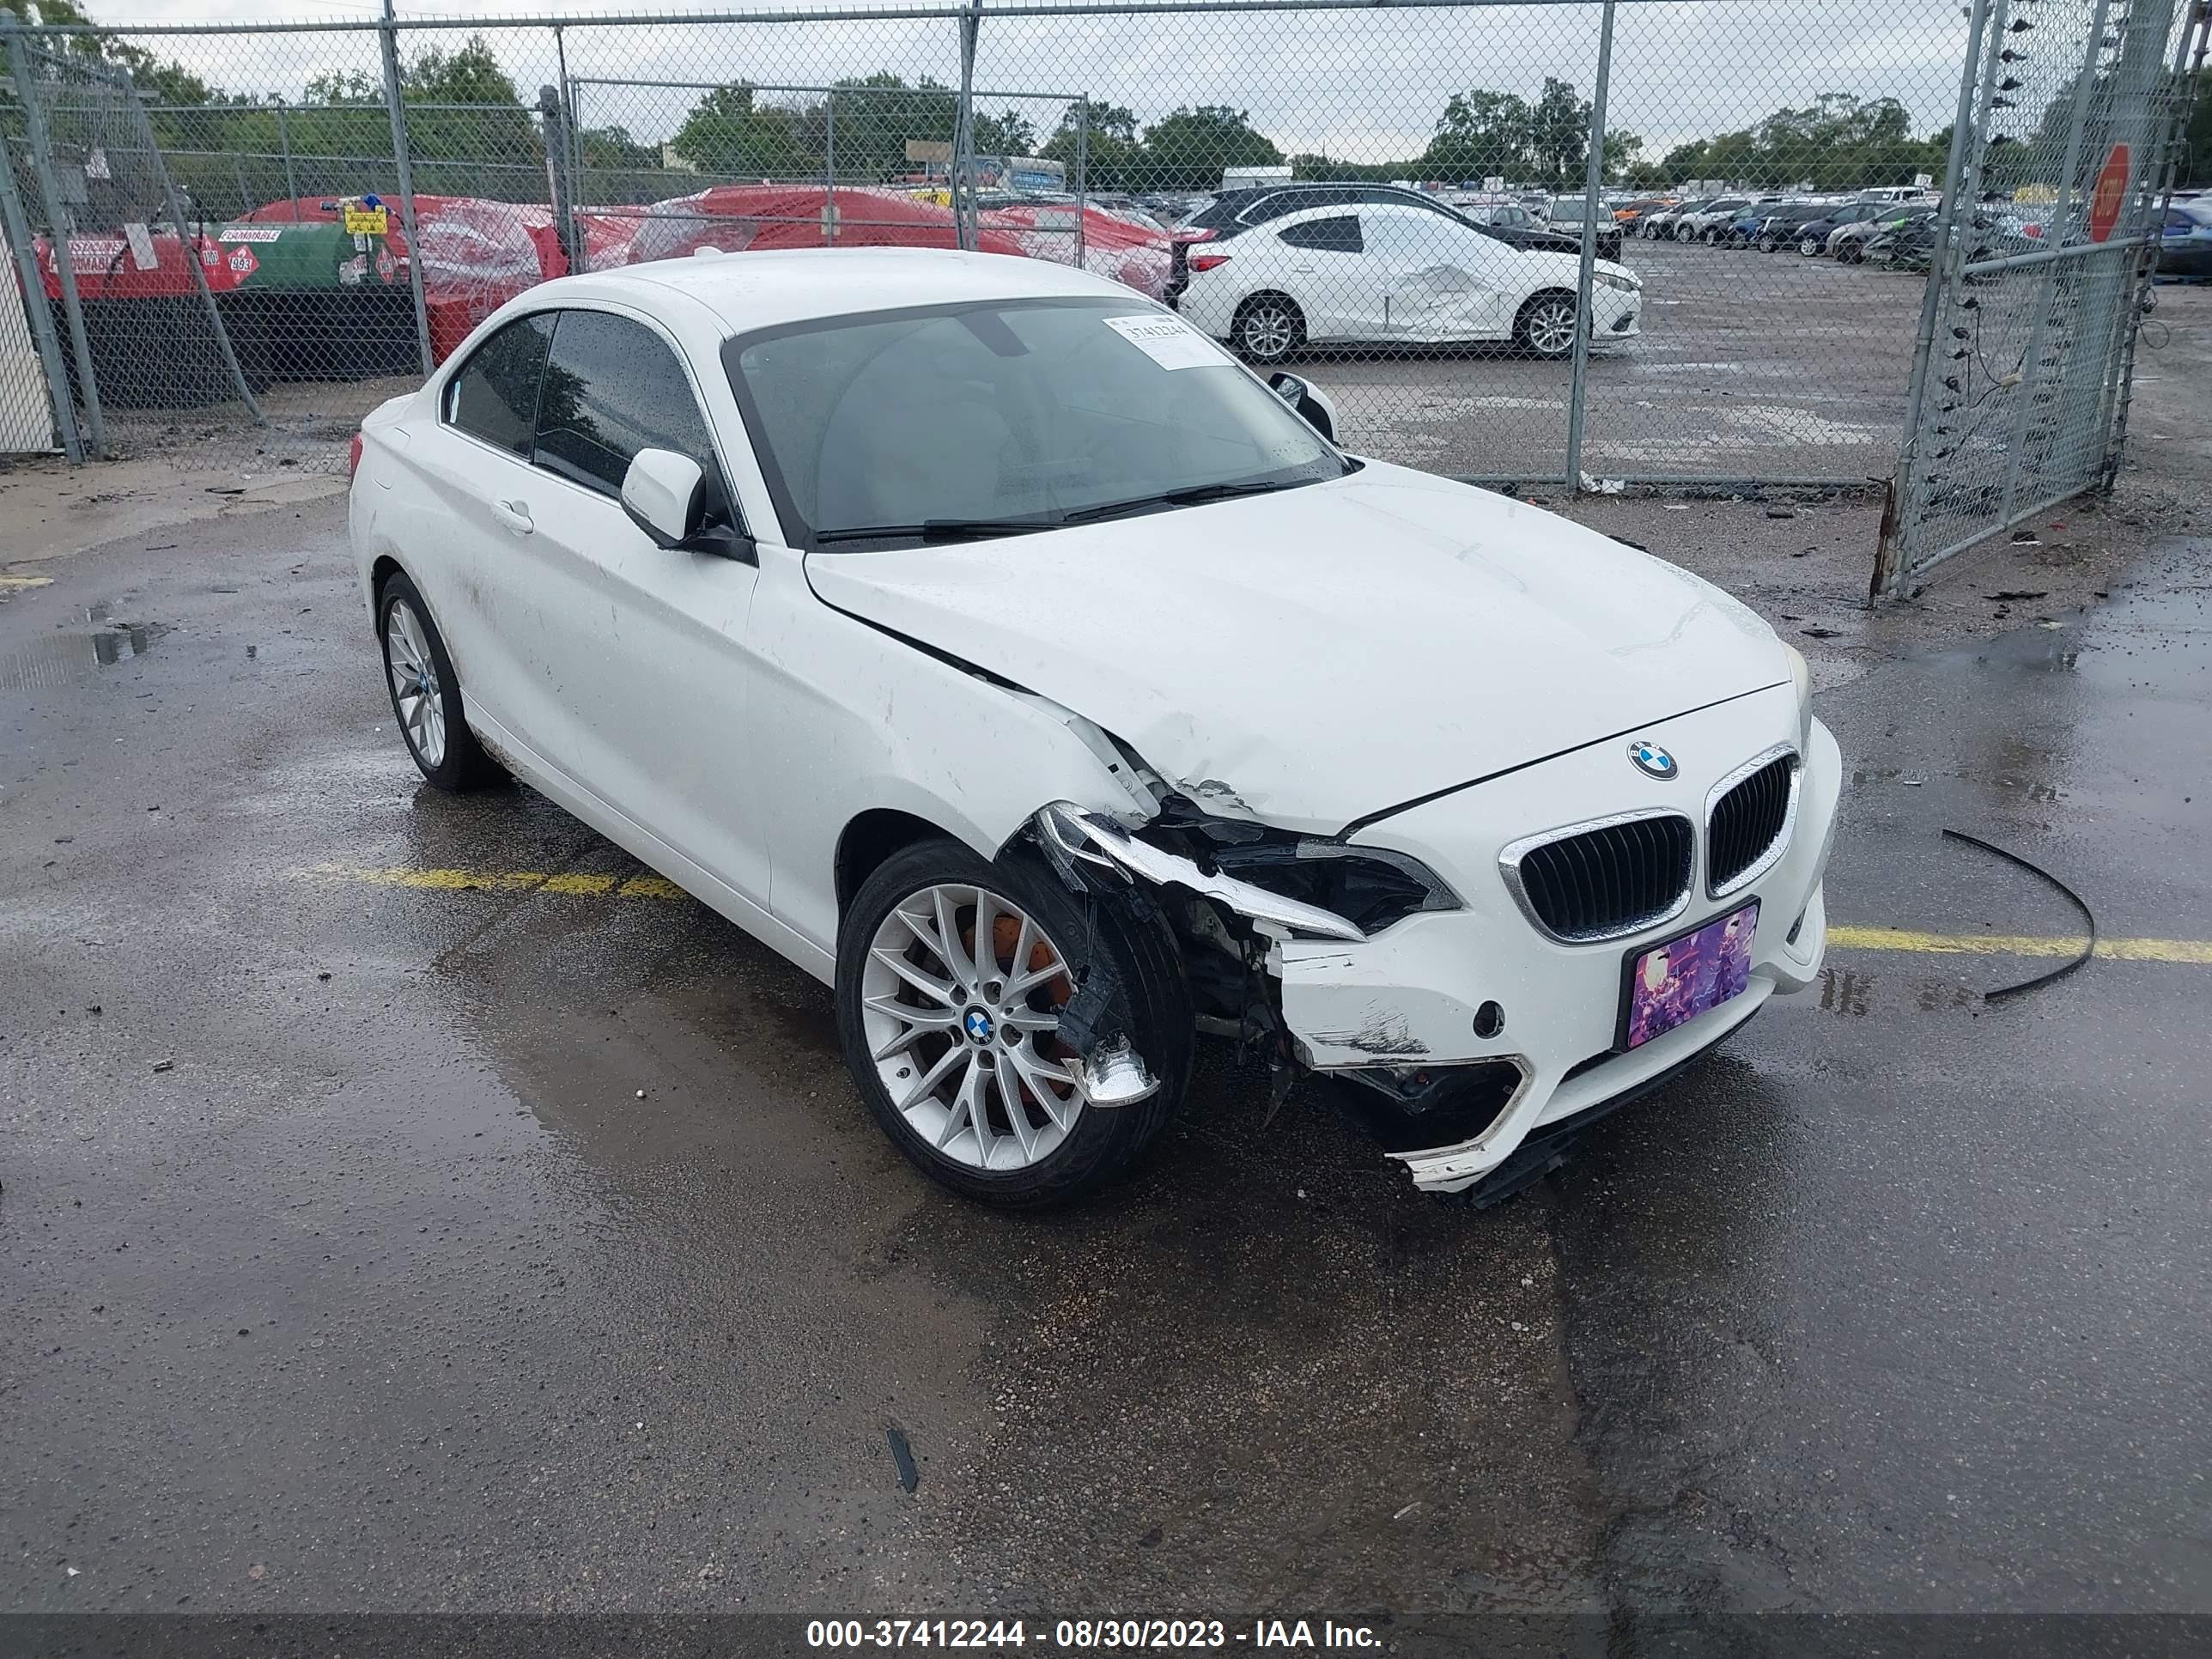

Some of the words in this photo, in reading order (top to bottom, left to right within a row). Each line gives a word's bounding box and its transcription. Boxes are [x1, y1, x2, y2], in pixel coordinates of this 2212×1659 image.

[2097, 178, 2124, 217] STOP
[222, 231, 277, 240] FLAMMABLE
[1126, 326, 1189, 338] 37412244
[1631, 741, 1661, 757] BMW
